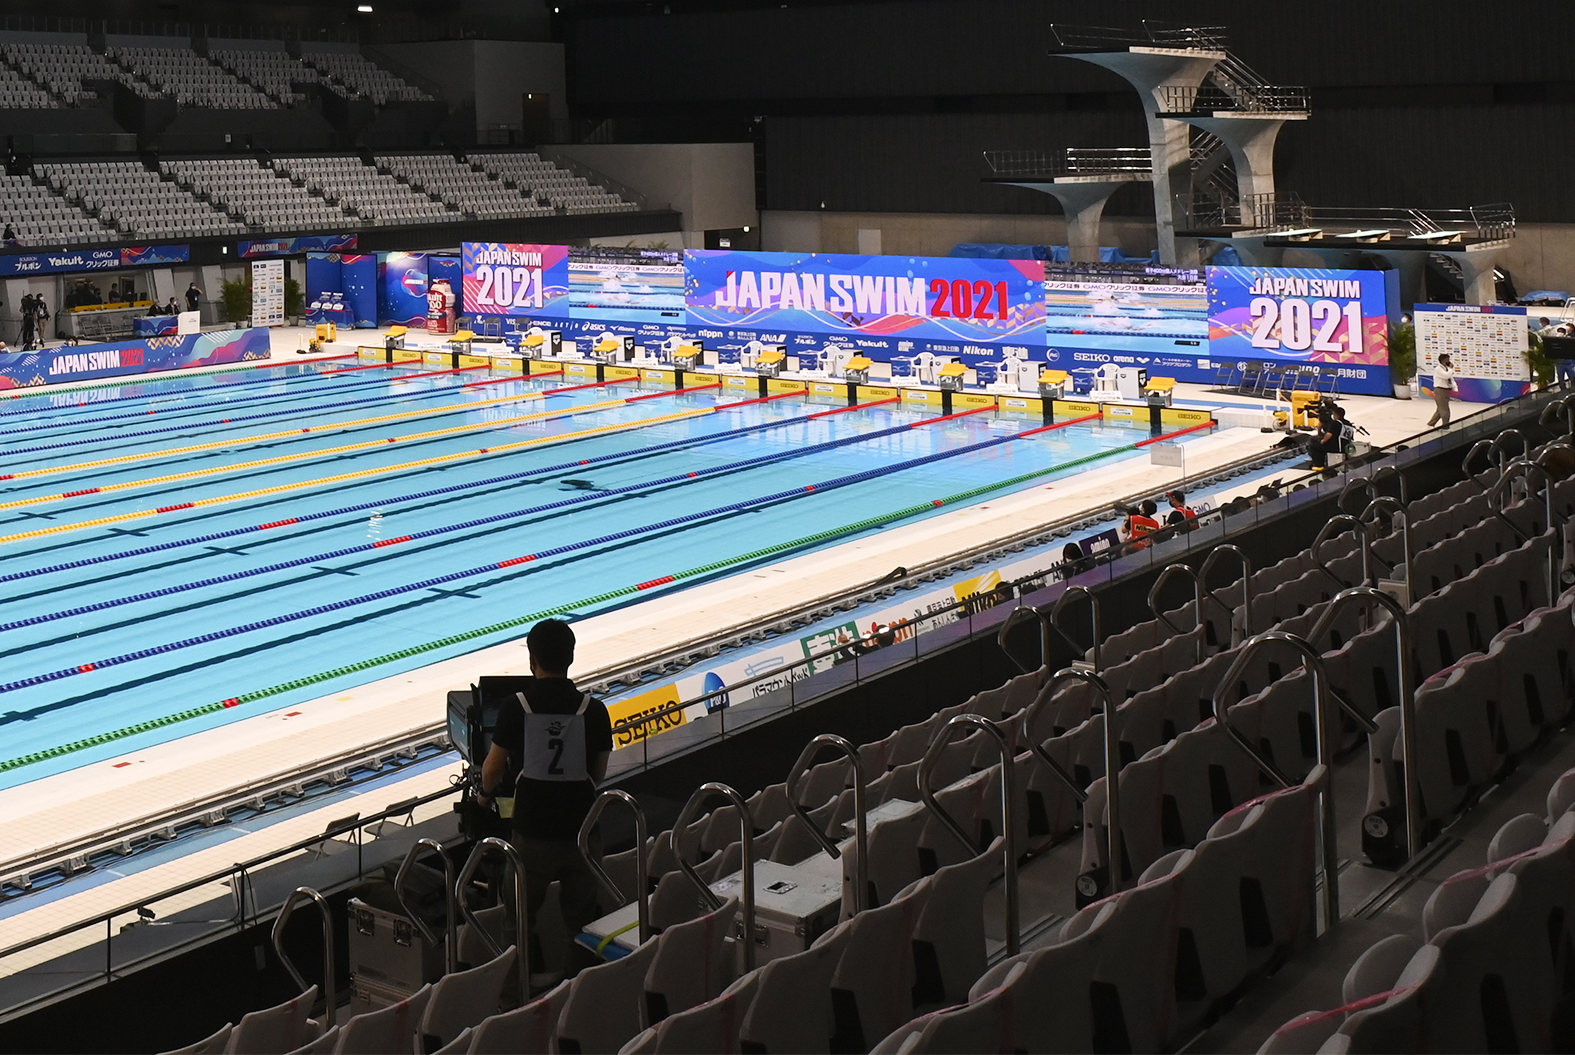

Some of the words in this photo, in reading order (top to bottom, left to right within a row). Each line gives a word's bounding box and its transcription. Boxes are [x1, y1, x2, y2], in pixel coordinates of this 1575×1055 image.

[48, 255, 84, 267] Yakult
[93, 251, 113, 259] GMO
[476, 251, 512, 265] JAPAN
[512, 251, 542, 267] SWIM
[15, 261, 42, 271] ブルボン
[85, 259, 119, 269] クリック証券
[476, 266, 543, 309] 2021
[1249, 277, 1309, 297] JAPAN
[1310, 279, 1361, 299] SWIM
[715, 271, 825, 313] JAPAN
[829, 273, 926, 317] SWIM
[930, 278, 1009, 321] 2021
[1249, 297, 1363, 353] 2021
[698, 329, 723, 339] nippn
[759, 333, 778, 343] ANA
[855, 339, 889, 348] Yakult
[963, 345, 994, 356] Nikon
[1002, 346, 1029, 359] 東進
[49, 353, 89, 375] JAPAN
[89, 350, 121, 371] SWIM
[121, 348, 145, 367] 2021
[1073, 352, 1111, 363] SEIKO
[1113, 355, 1135, 363] arena
[1090, 536, 1111, 554] amino
[614, 700, 683, 746] SEIKO
[548, 738, 564, 775] 2
